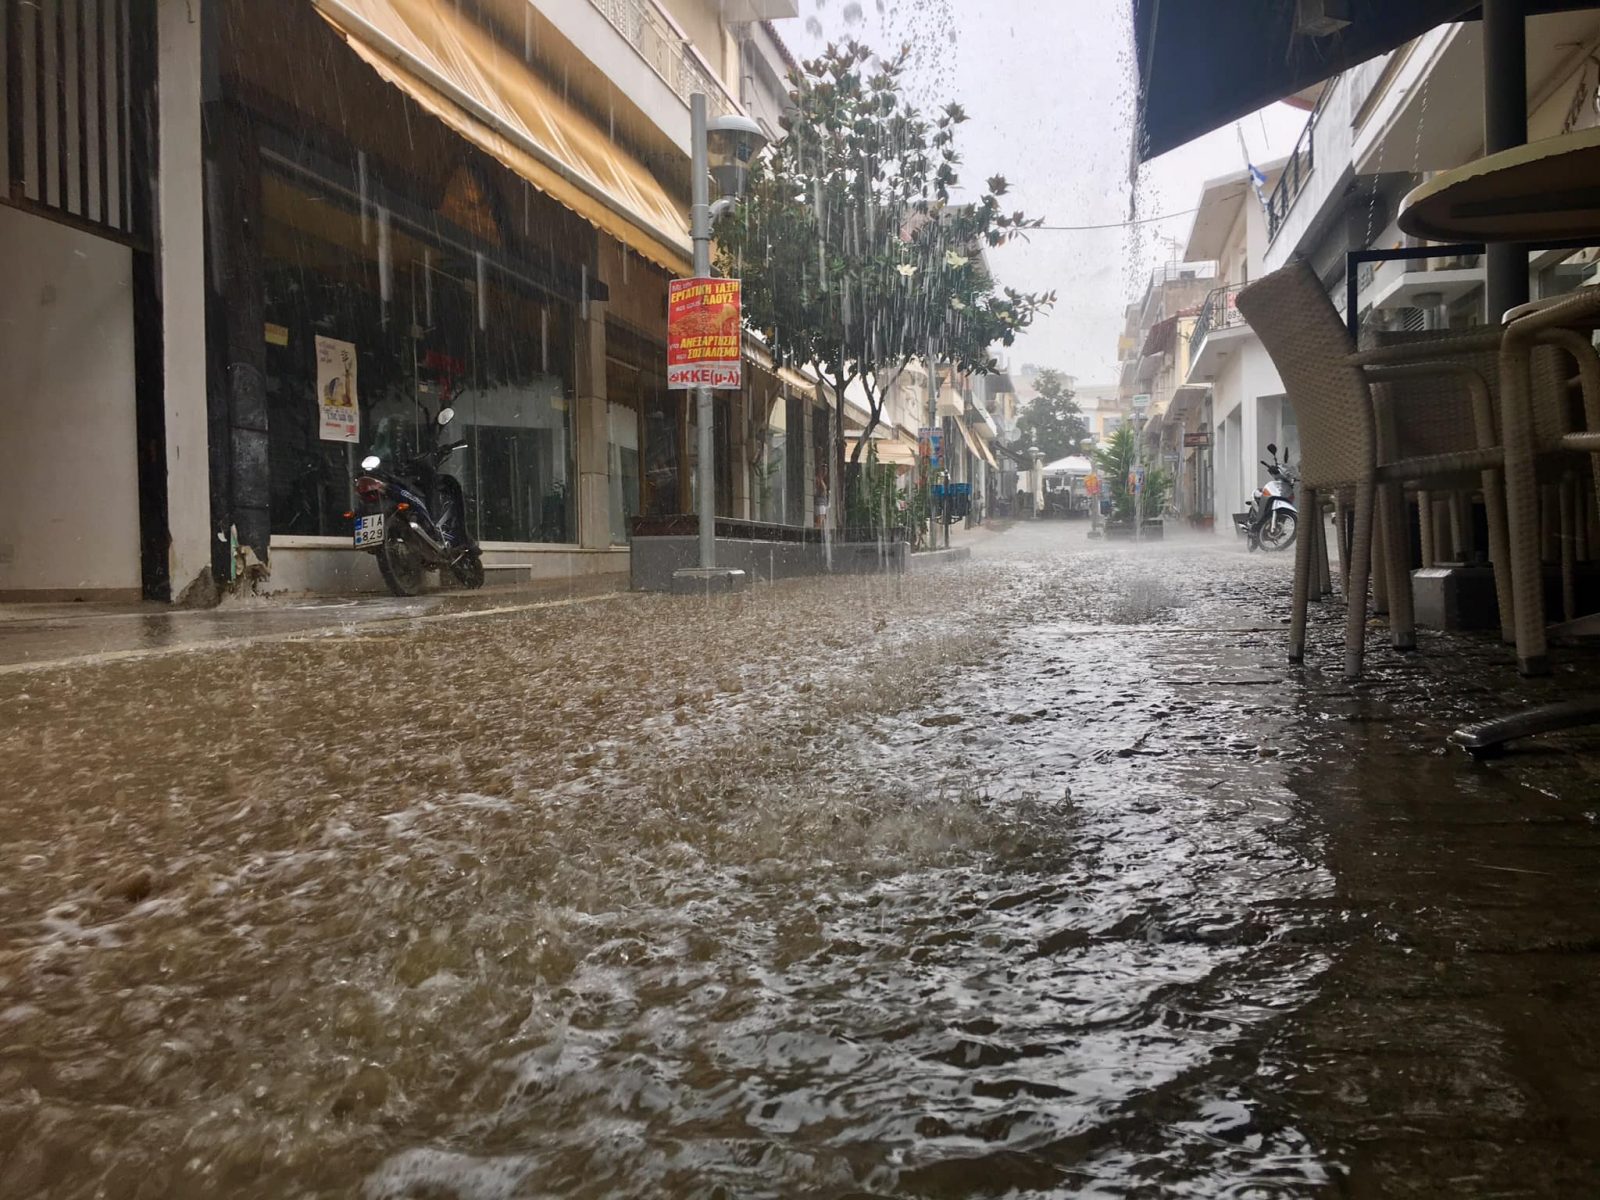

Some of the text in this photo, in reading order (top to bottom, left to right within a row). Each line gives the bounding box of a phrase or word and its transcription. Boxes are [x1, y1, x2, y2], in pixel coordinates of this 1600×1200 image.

[671, 281, 739, 304] ΕΡΓΑΤΙΚΗ ΤΑΞΗ
[703, 292, 734, 305] ΛΑΟΥΣ
[680, 335, 738, 349] ΑΝΕΞΑΡΤΗΣΙΑ
[687, 346, 739, 359] ΣΟΣΙΑΛΙΣΜΟ
[362, 529, 383, 542] 829
